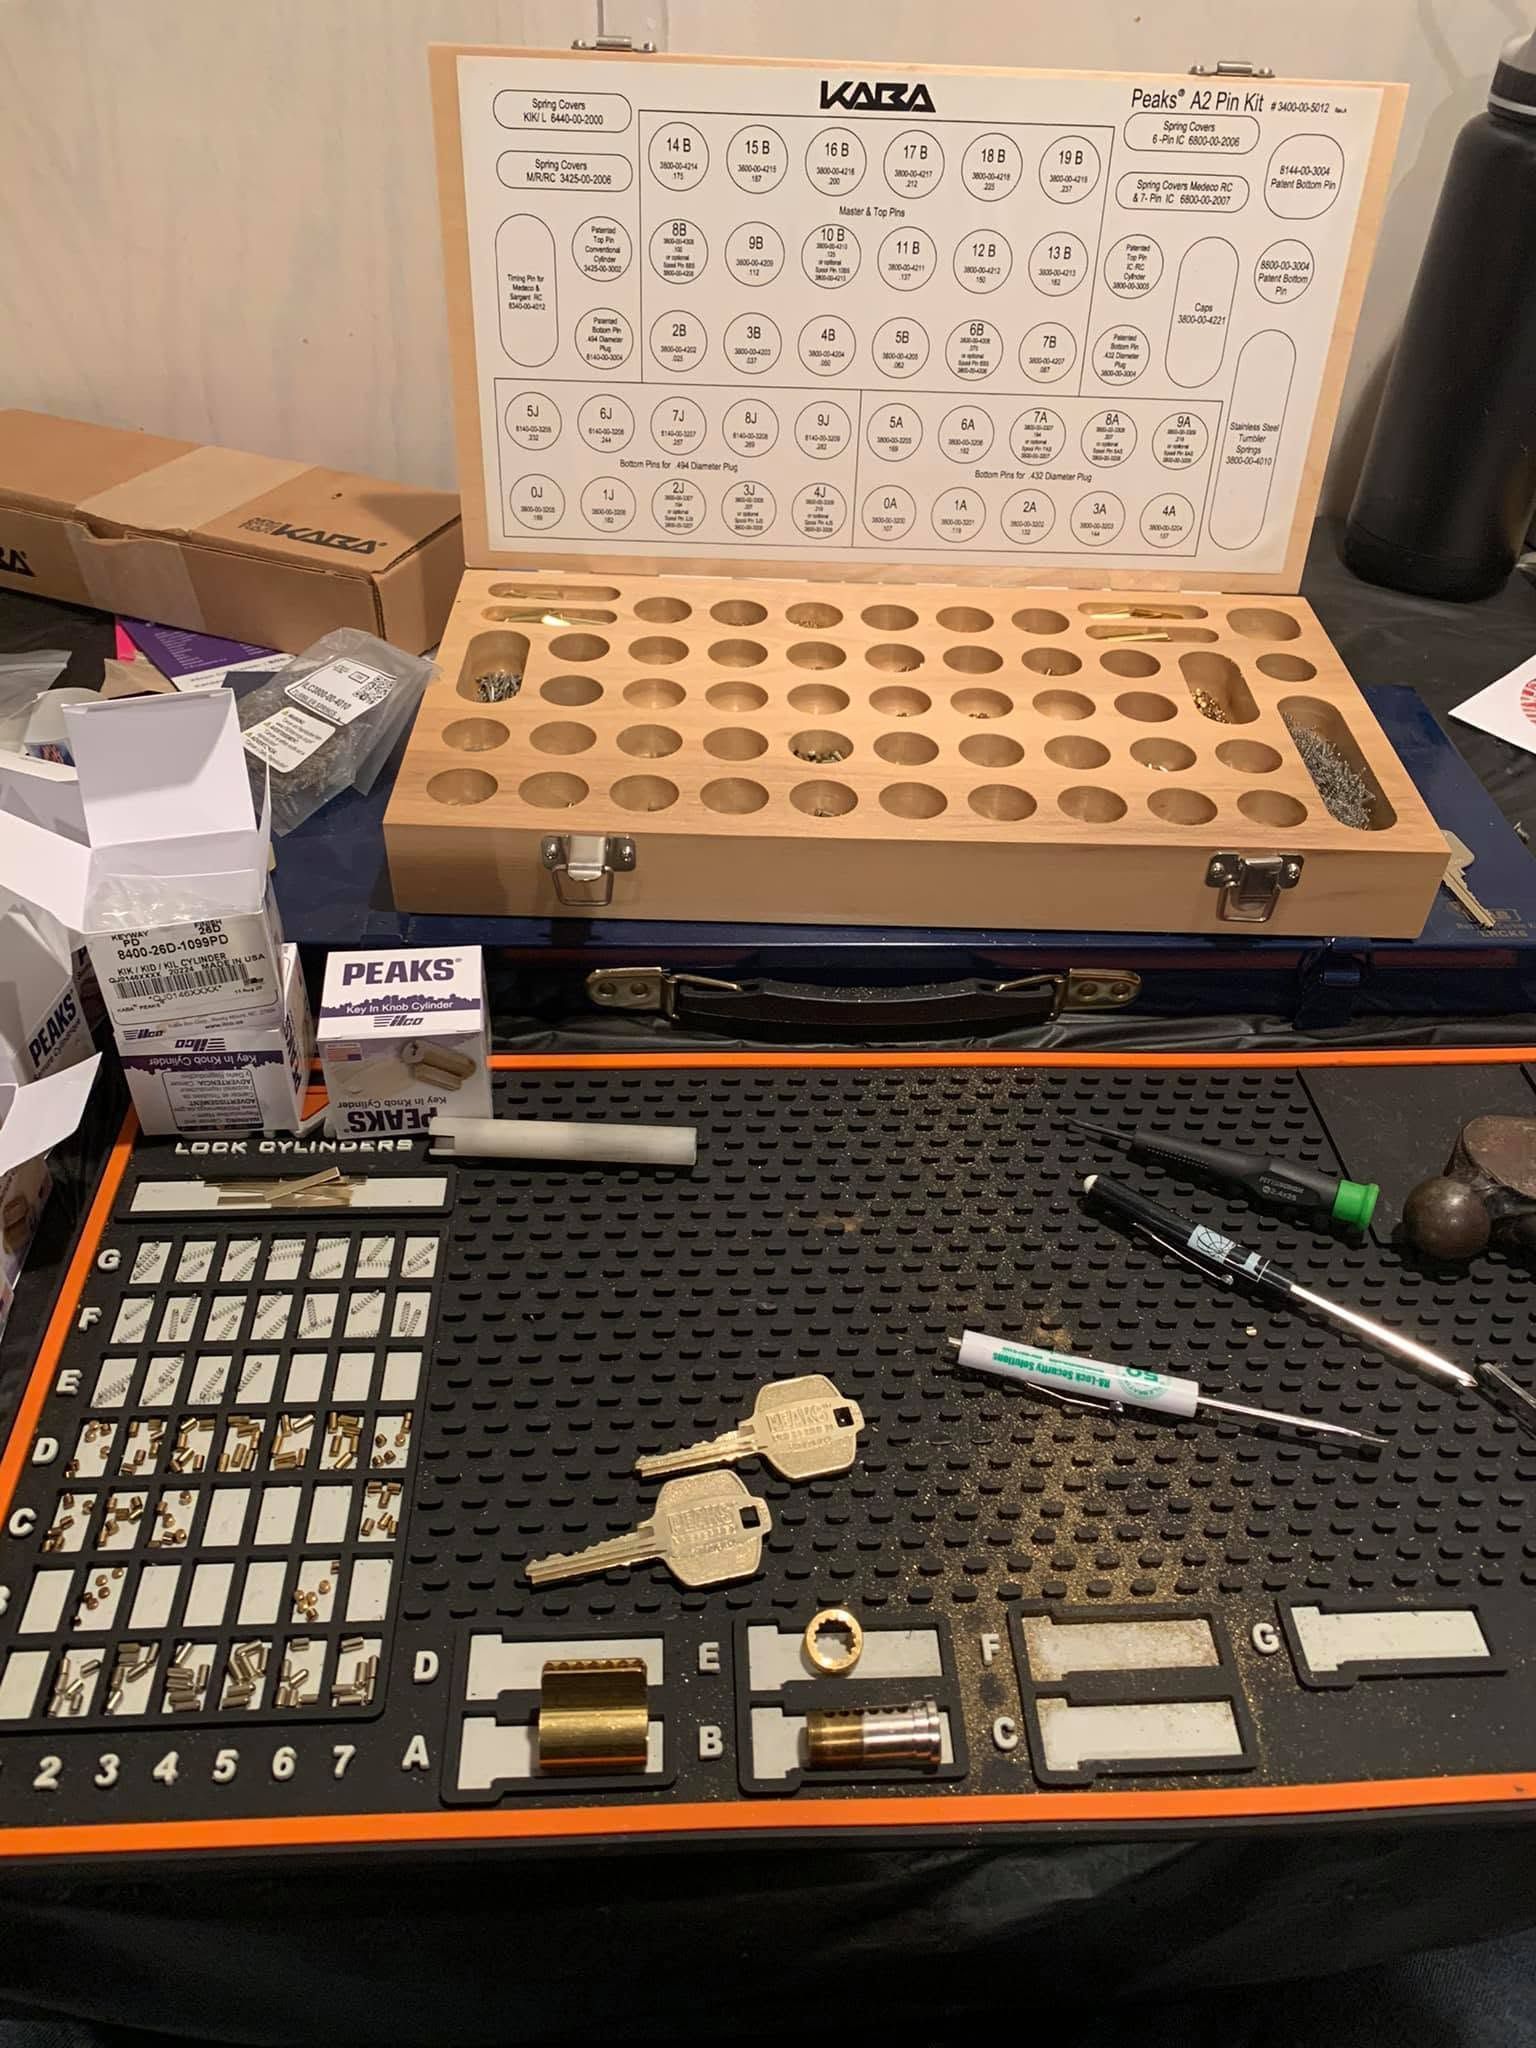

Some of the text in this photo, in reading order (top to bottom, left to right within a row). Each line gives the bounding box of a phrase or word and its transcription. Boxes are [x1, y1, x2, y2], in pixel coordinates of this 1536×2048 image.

[820, 80, 936, 113] KABA
[1189, 90, 1211, 110] A2
[1215, 92, 1239, 112] Pin
[1244, 92, 1264, 112] Kit
[1270, 100, 1277, 112] #
[1278, 101, 1330, 114] 3400-00-5012
[531, 98, 586, 112] Spring Covers
[1163, 120, 1216, 133] Spring Covers
[666, 138, 691, 152] 14 B
[745, 140, 770, 155] 15 B
[824, 142, 849, 158] 16 B
[903, 144, 928, 160] 17 B
[980, 148, 1006, 164] 18 B
[1058, 150, 1084, 166] 19 B
[535, 158, 587, 172] Spring Covers
[526, 172, 612, 185] M/R/RC 3425-00-2006
[1270, 178, 1336, 190] Patent Bottom Pin
[1136, 179, 1233, 193] Spring Covers Medeco RC
[839, 206, 906, 219] Master & Top Pins
[671, 222, 686, 237] 8B
[821, 228, 845, 242] 10 B
[748, 236, 764, 250] 9B
[896, 241, 920, 255] 11 B
[972, 244, 996, 258] 12 B
[1048, 246, 1072, 260] 13 B
[1258, 273, 1308, 284] Patent Bottom
[1275, 286, 1287, 296] Pin
[1194, 302, 1214, 313] Caps
[672, 323, 686, 337] 2B
[746, 326, 761, 340] 3B
[820, 328, 836, 342] 4B
[969, 322, 984, 337] 6B
[895, 330, 909, 344] 5B
[1042, 335, 1057, 349] 7B
[526, 404, 539, 418] 5J
[600, 407, 612, 420] 6J
[672, 409, 685, 422] 7J
[744, 411, 758, 424] 8J
[1034, 411, 1048, 423] 7A
[816, 414, 830, 426] 9J
[888, 416, 904, 429] 5A
[960, 418, 975, 431] 6A
[1105, 413, 1120, 426] 8A
[1176, 415, 1191, 428] 9A
[1229, 422, 1279, 432] Stainless Steel
[1238, 433, 1266, 443] Tumbler
[1235, 444, 1262, 456] Springs
[974, 469, 999, 479] Bottom
[1000, 470, 1014, 480] Pins
[1016, 470, 1026, 480] for
[1044, 471, 1075, 481] Diameter
[1076, 472, 1092, 482] Plug
[530, 486, 543, 498] 0J
[602, 488, 614, 501] 1J
[672, 481, 685, 494] 2J
[743, 484, 756, 496] 3J
[814, 486, 826, 498] 4J
[883, 497, 898, 509] 0A
[954, 499, 968, 512] 1A
[1023, 501, 1037, 513] 2A
[1093, 503, 1107, 515] 3A
[1162, 504, 1176, 517] 4A
[270, 524, 376, 554] KABA
[112, 930, 149, 941] KEYWAY
[198, 925, 221, 935] 26D
[117, 934, 229, 960] 8400-26D-1099PD
[123, 939, 140, 947] PD
[141, 964, 157, 972] KID
[181, 952, 227, 967] CYLINDER
[169, 966, 194, 976] 20224
[202, 961, 229, 970] MADE
[244, 953, 265, 962] USA
[346, 1006, 366, 1014] Key
[382, 1003, 409, 1012] Knob
[411, 1001, 454, 1011] Cylinder
[28, 994, 77, 1068] PEAKS
[149, 1058, 192, 1066] Cylinder
[194, 1056, 221, 1065] Knob
[236, 1055, 256, 1064] Key
[337, 1100, 381, 1108] Cylinder
[384, 1099, 411, 1107] Knob
[175, 1138, 415, 1155] LOCK CYLINDERS
[96, 1248, 122, 1272] G
[78, 1308, 102, 1332] F
[993, 1352, 1028, 1370] Solutions
[1029, 1362, 1073, 1382] Security
[55, 1369, 82, 1396] E
[31, 1437, 60, 1465] D
[9, 1508, 38, 1537] C
[1251, 1622, 1280, 1655] G
[982, 1634, 1000, 1666] F
[698, 1642, 722, 1674] E
[414, 1651, 440, 1683] D
[992, 1717, 1019, 1751] C
[698, 1727, 724, 1761] B
[402, 1735, 431, 1770] A
[33, 1745, 356, 1790] 2 3 4 5 6 7
